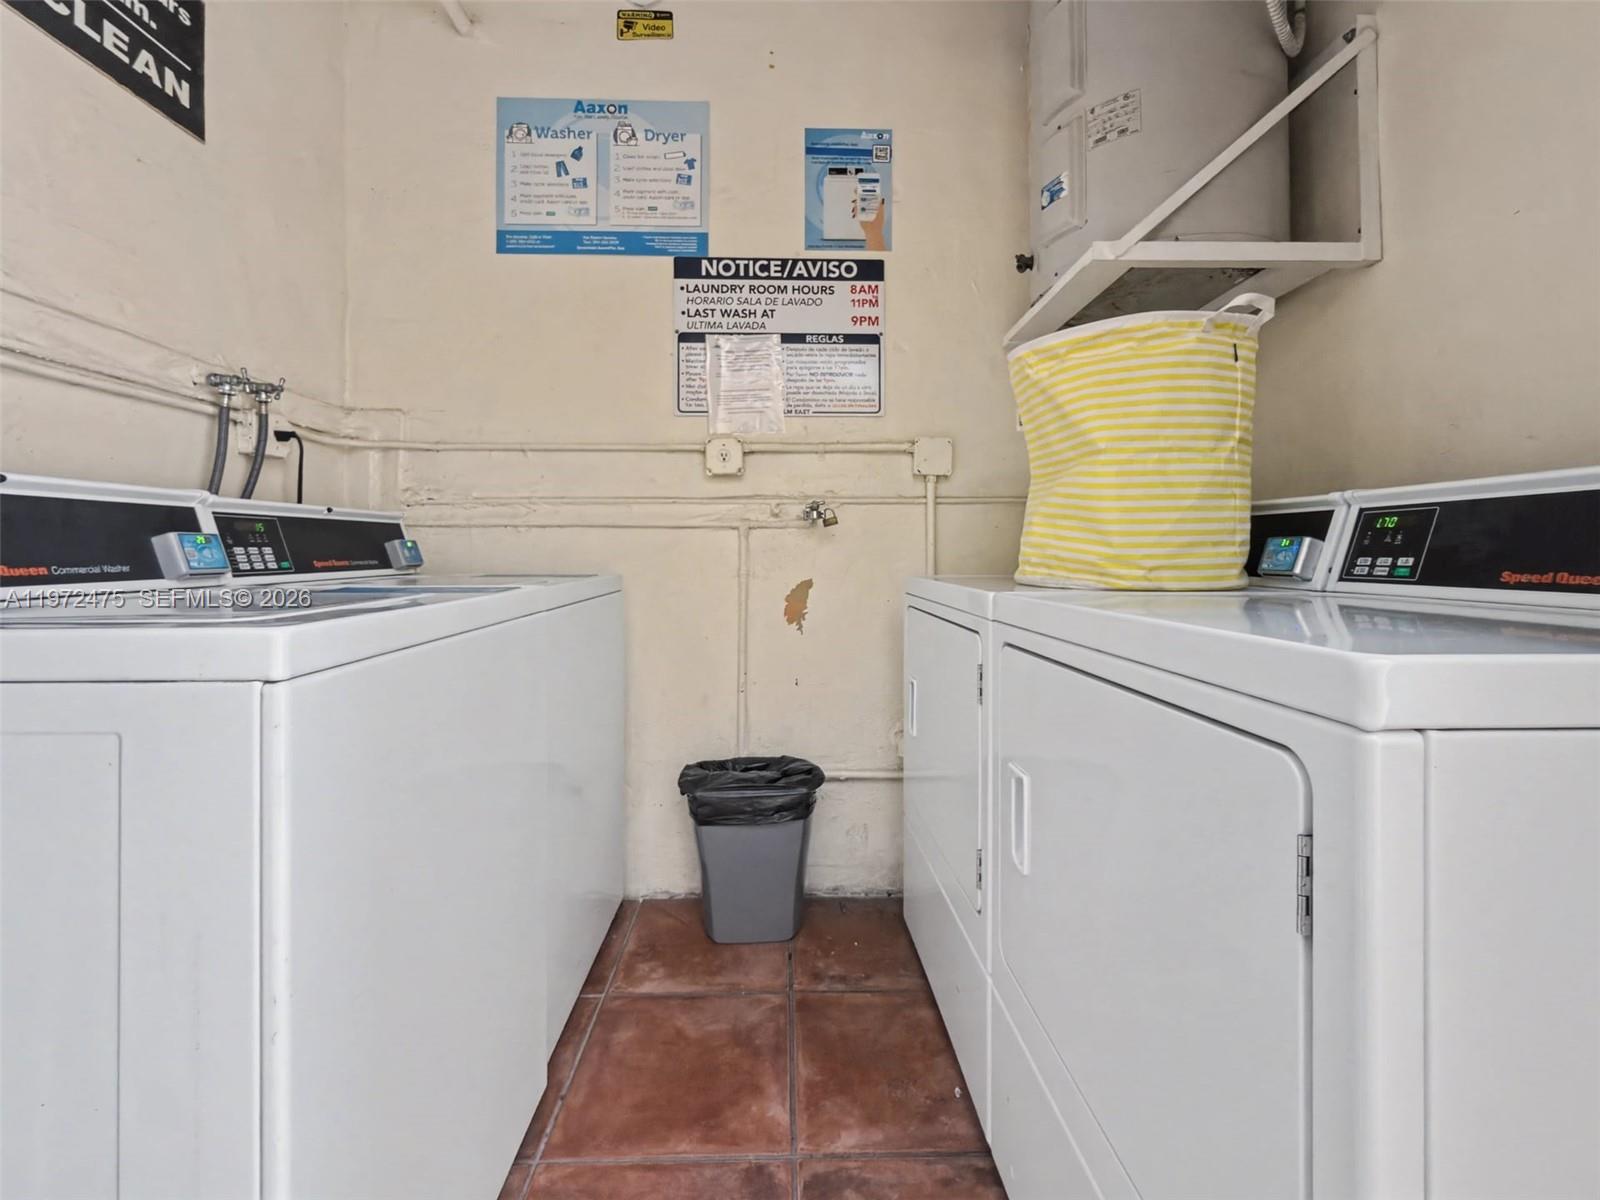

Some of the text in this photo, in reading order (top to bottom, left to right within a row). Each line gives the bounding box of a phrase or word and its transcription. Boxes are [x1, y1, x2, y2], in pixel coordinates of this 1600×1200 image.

[642, 23, 666, 31] Video
[574, 100, 628, 114] Aaxon
[534, 126, 593, 140] Washer
[644, 129, 686, 145] Dryer
[701, 259, 858, 278] NOTICE/AVISO
[686, 284, 835, 295] LAUNDRY ROOM HOURS
[850, 284, 878, 294] 8AM
[686, 296, 823, 306] HORARIO SALA DE LAVADO
[851, 299, 879, 308] 11PM
[687, 308, 776, 318] LAST WASH AT
[686, 321, 766, 330] ULTIMA LAVADA
[851, 316, 879, 326] 9PM
[805, 334, 844, 343] REGLAS
[0, 565, 48, 576] Queen
[51, 565, 100, 575] Commercial
[1500, 571, 1554, 584] Speed
